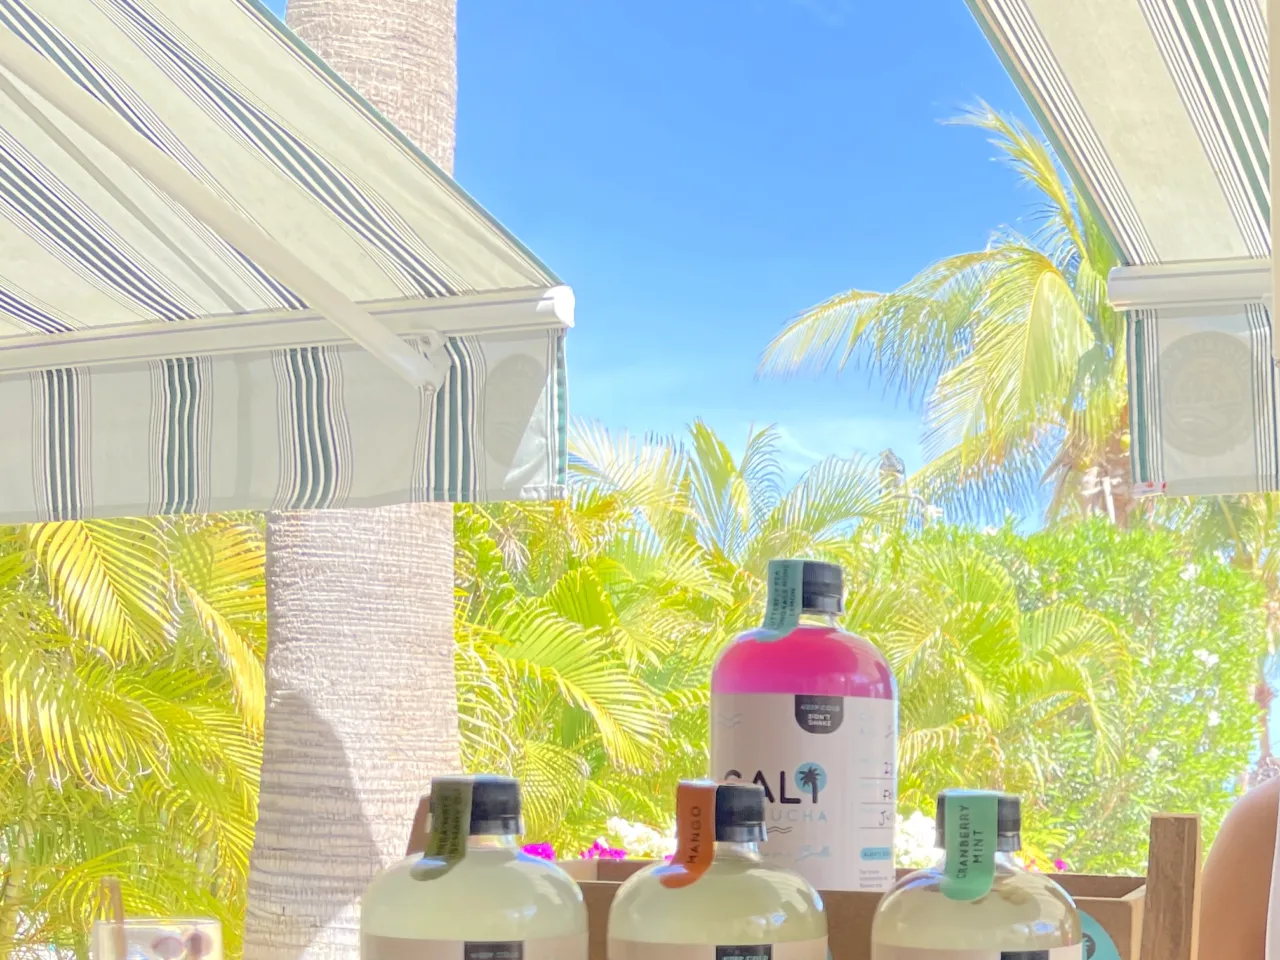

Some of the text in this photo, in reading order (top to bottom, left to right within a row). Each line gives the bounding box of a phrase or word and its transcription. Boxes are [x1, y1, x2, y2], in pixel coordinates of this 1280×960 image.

[686, 806, 701, 864] MANGO
[956, 804, 970, 879] CRANBERRY
[972, 829, 984, 864] MINT
